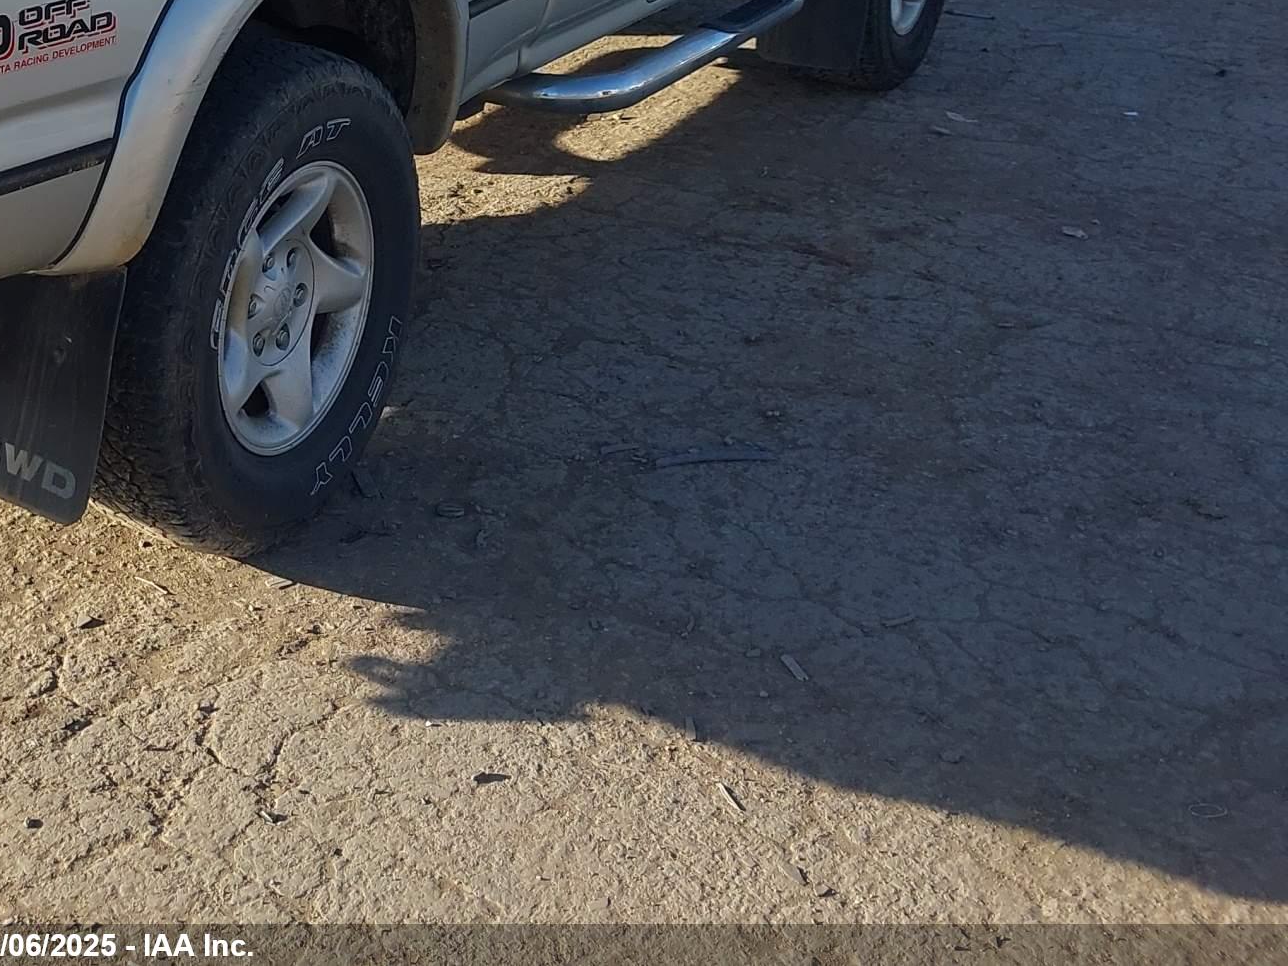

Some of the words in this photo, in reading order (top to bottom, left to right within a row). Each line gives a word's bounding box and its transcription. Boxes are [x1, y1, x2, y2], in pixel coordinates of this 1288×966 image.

[18, 11, 117, 55] ROAD
[13, 54, 49, 72] RACING
[52, 36, 116, 61] DEVELOPMENT
